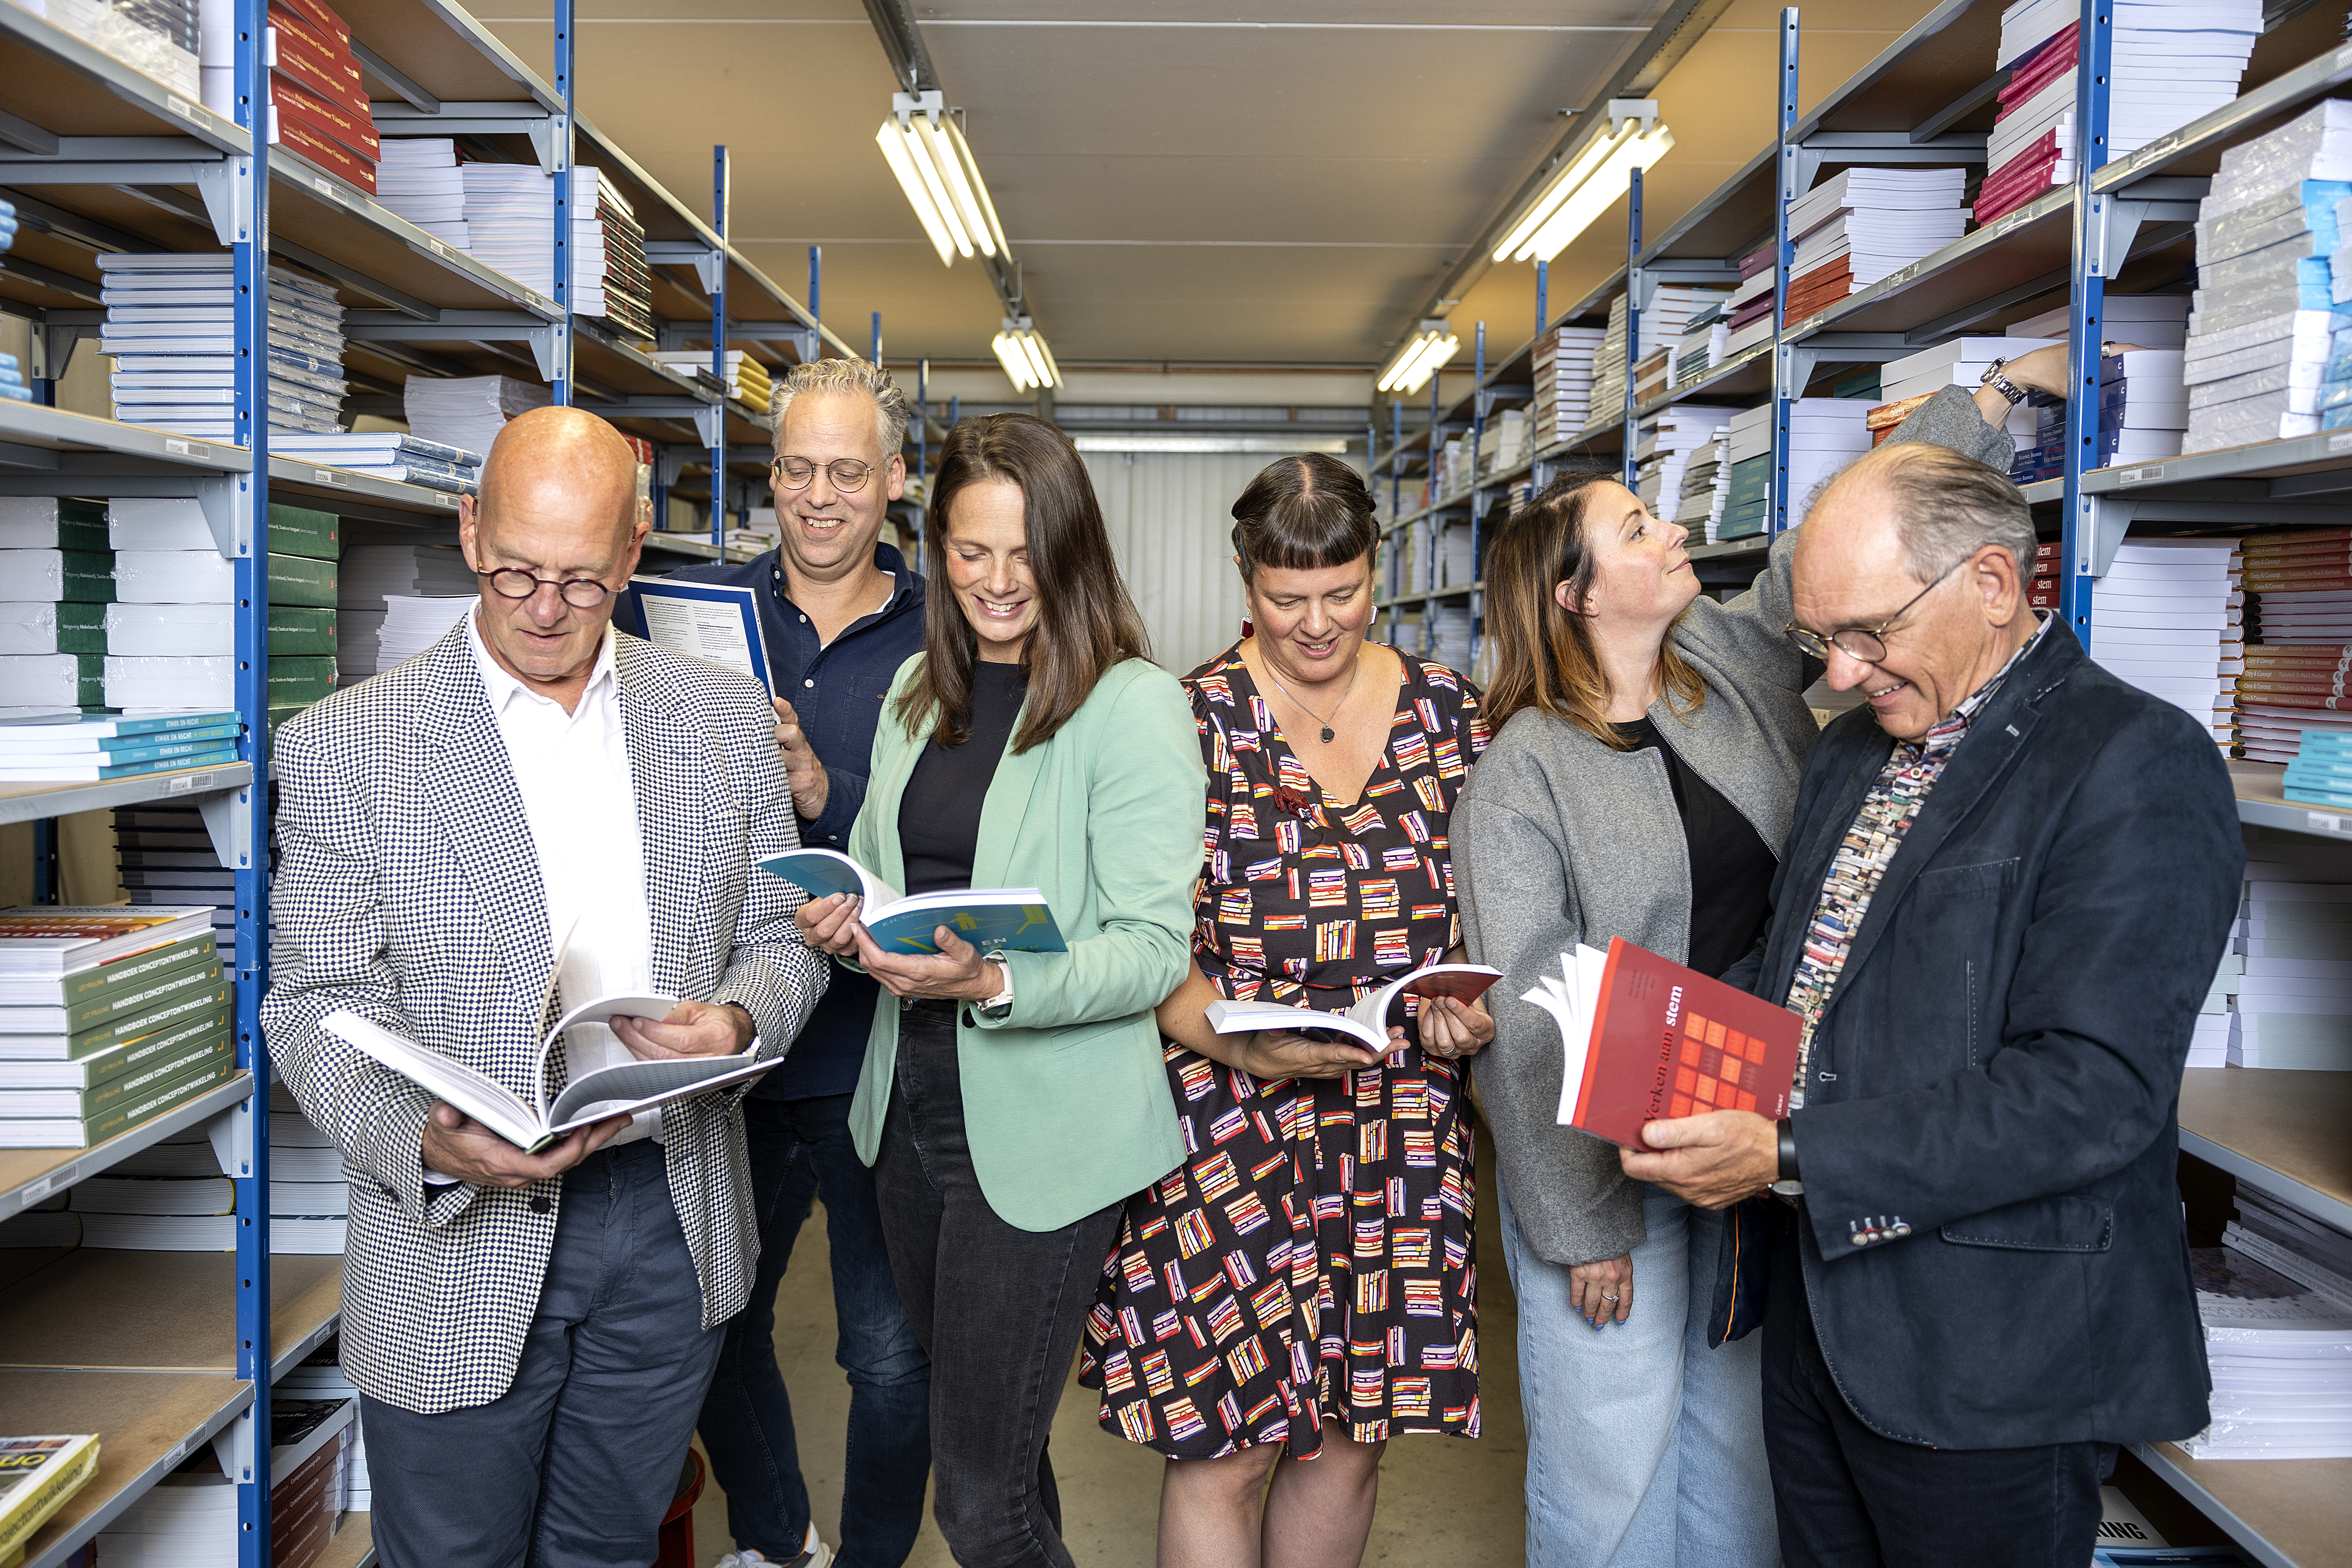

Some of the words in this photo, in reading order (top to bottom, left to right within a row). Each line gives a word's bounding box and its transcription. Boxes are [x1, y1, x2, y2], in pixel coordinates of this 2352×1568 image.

[295, 93, 322, 113] Privaatrecht
[322, 109, 332, 119] voor
[332, 113, 351, 130] Vastgoed
[300, 130, 324, 150] Privaatrecht
[324, 146, 333, 155] voor
[333, 149, 350, 165] Vastgoed
[2036, 563, 2048, 573] tem
[2037, 579, 2052, 589] stem
[2032, 595, 2047, 605] stem
[155, 734, 169, 742] ETHIEK
[981, 937, 1008, 946] EN
[107, 968, 138, 983] HANDBOEK
[138, 947, 199, 973] CONCEPTONTWIKKELING
[113, 994, 144, 1011] HANDBOEK
[144, 972, 205, 998] CONCEPTONTWIKKELING
[1666, 985, 1683, 1027] stem
[115, 1019, 148, 1036] HANDBOEK
[148, 995, 212, 1023] CONCEPTONTWIKKELING
[127, 1046, 156, 1063] HANDBOEK
[156, 1020, 214, 1050] CONCEPTONTWIKKELING
[1660, 1029, 1674, 1062] aan
[123, 1074, 154, 1091] HANDBOEK
[154, 1046, 213, 1078] CONCEPTONTWIKKELING
[127, 1100, 157, 1119] HANDBOEK
[158, 1072, 216, 1105] CONCEPTONTWIKKELING
[315, 1330, 327, 1344] 000072
[2185, 1442, 2190, 1451] C
[291, 1455, 321, 1484] Computertomografie
[290, 1478, 319, 1507] Computertomografie
[291, 1501, 318, 1531] Computertomografie
[291, 1525, 318, 1556] Computertomografie
